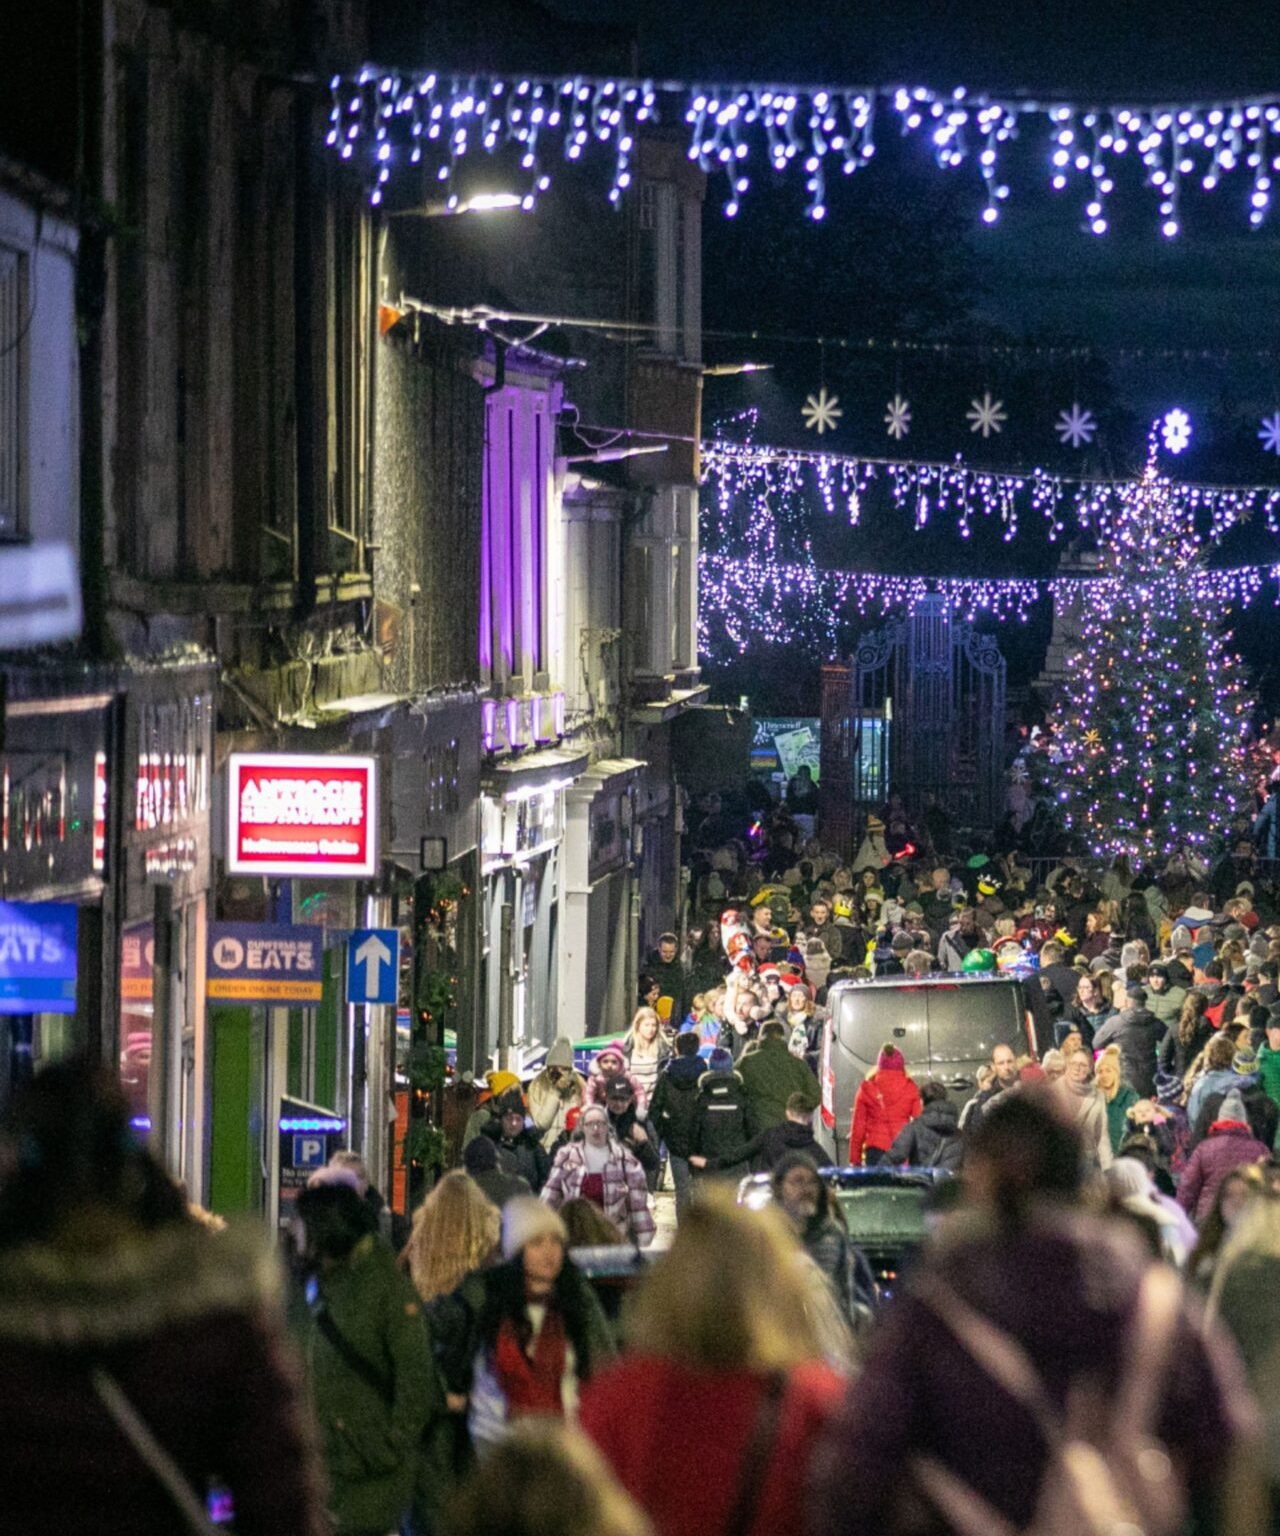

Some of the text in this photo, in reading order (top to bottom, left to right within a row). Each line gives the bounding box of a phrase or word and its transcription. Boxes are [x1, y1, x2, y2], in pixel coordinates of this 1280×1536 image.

[241, 779, 363, 805] ANTIOCH
[241, 806, 362, 825] RESTAURANT
[247, 951, 313, 970] EATS
[215, 985, 313, 994] ORDER ONLINE TODAY
[302, 1140, 321, 1162] P
